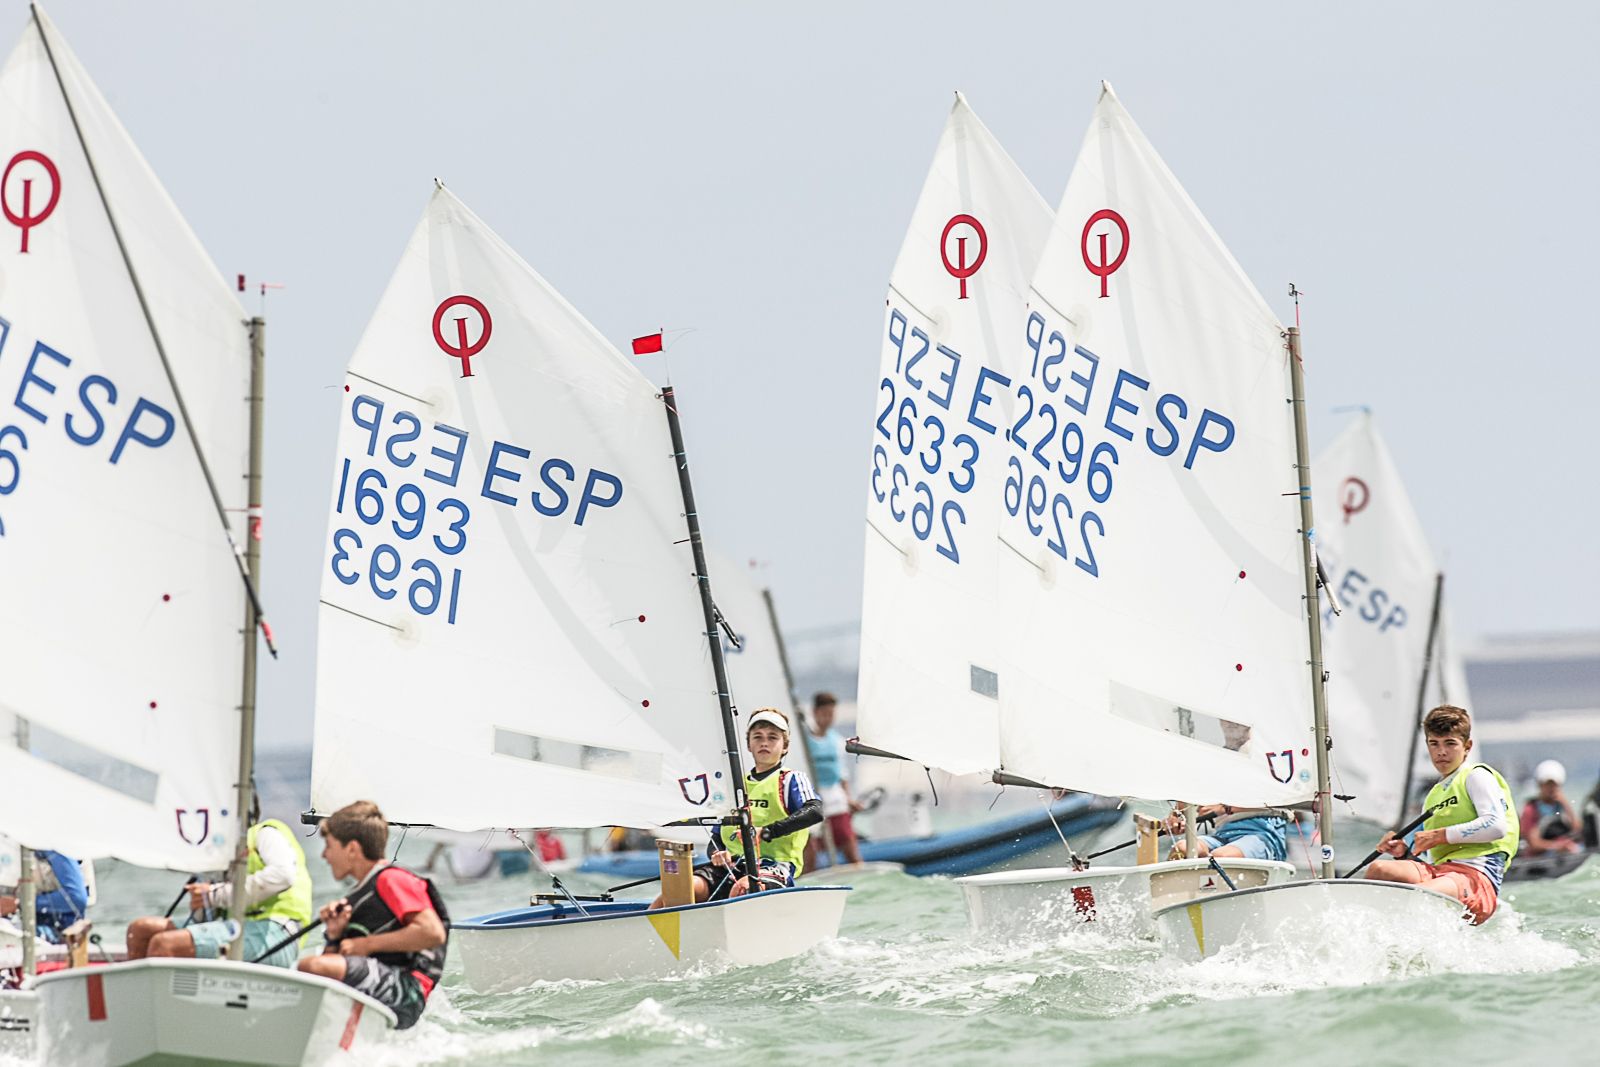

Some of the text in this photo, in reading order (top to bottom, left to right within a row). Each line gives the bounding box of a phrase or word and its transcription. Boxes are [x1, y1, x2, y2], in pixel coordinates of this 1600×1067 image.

[14, 340, 175, 465] ESP
[876, 378, 979, 493] 2633
[1011, 385, 1119, 504] 2296
[1104, 369, 1235, 470] ESP
[336, 457, 470, 555] 1693
[481, 441, 623, 526] ESP
[1337, 568, 1408, 633] ESP
